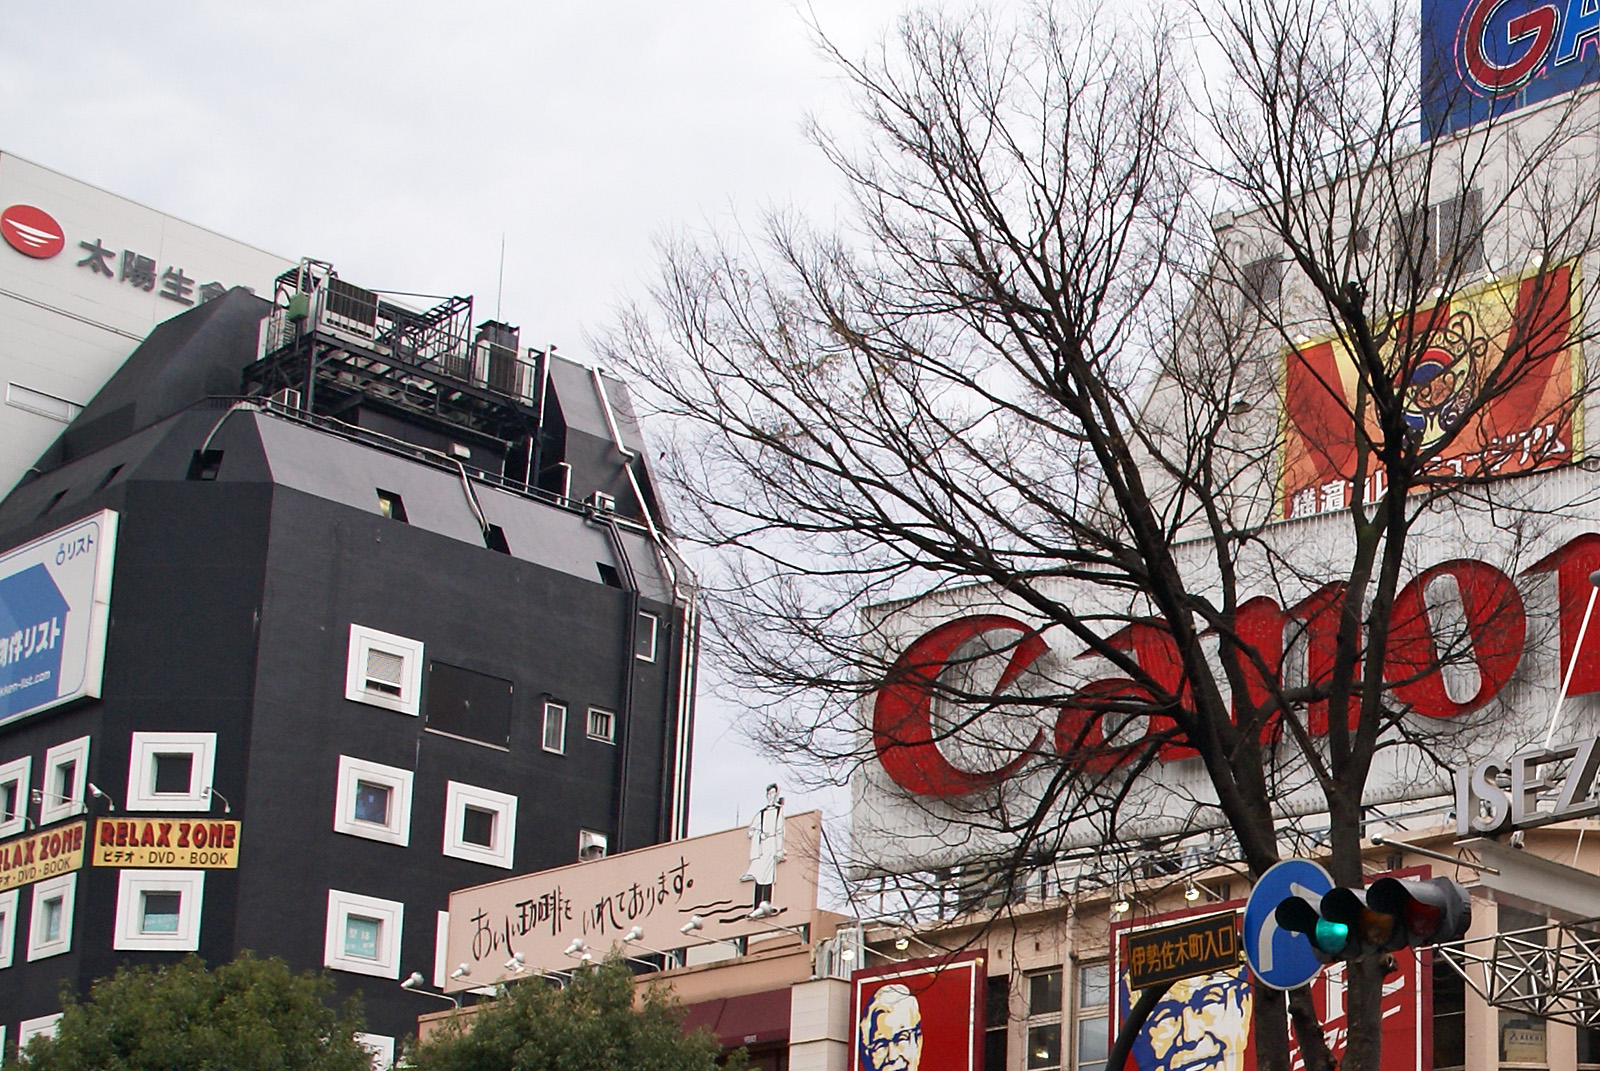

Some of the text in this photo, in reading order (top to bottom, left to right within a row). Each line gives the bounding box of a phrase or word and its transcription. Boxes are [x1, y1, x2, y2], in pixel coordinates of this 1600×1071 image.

[39, 825, 83, 861] ZONE
[100, 822, 236, 849] RELAX ZONE
[1131, 925, 1234, 977] 伊勢佐木町入口
